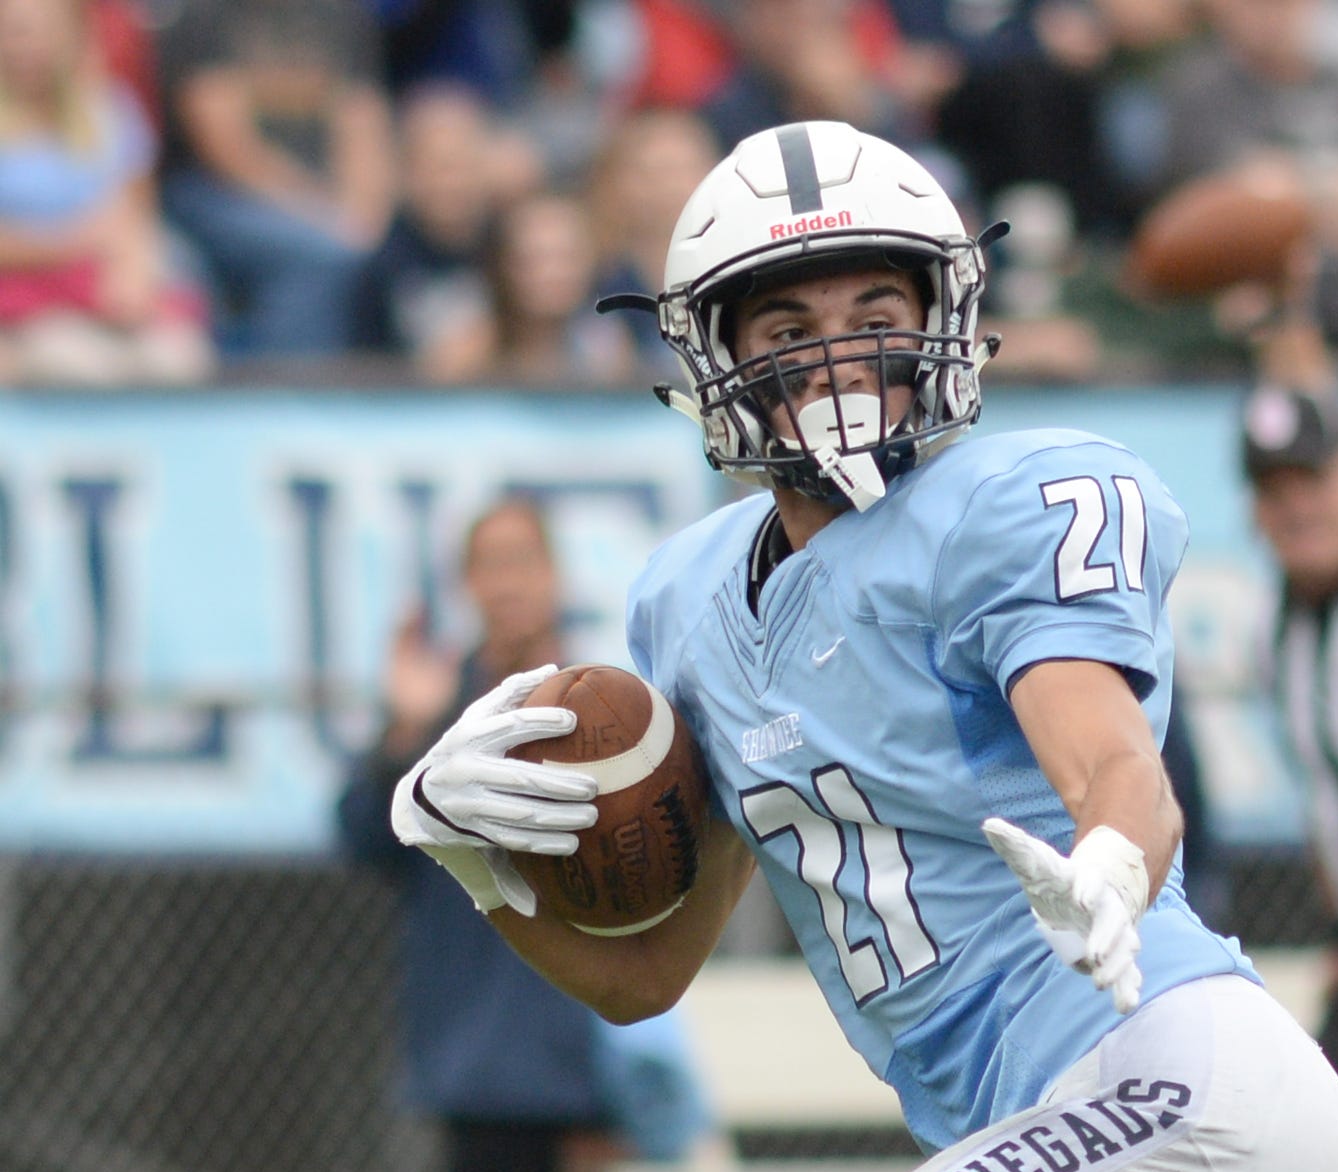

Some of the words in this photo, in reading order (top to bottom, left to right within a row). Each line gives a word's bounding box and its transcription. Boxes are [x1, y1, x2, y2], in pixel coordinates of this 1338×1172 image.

[769, 210, 852, 240] Riddell
[1039, 475, 1147, 604] 21
[738, 761, 941, 1009] 21
